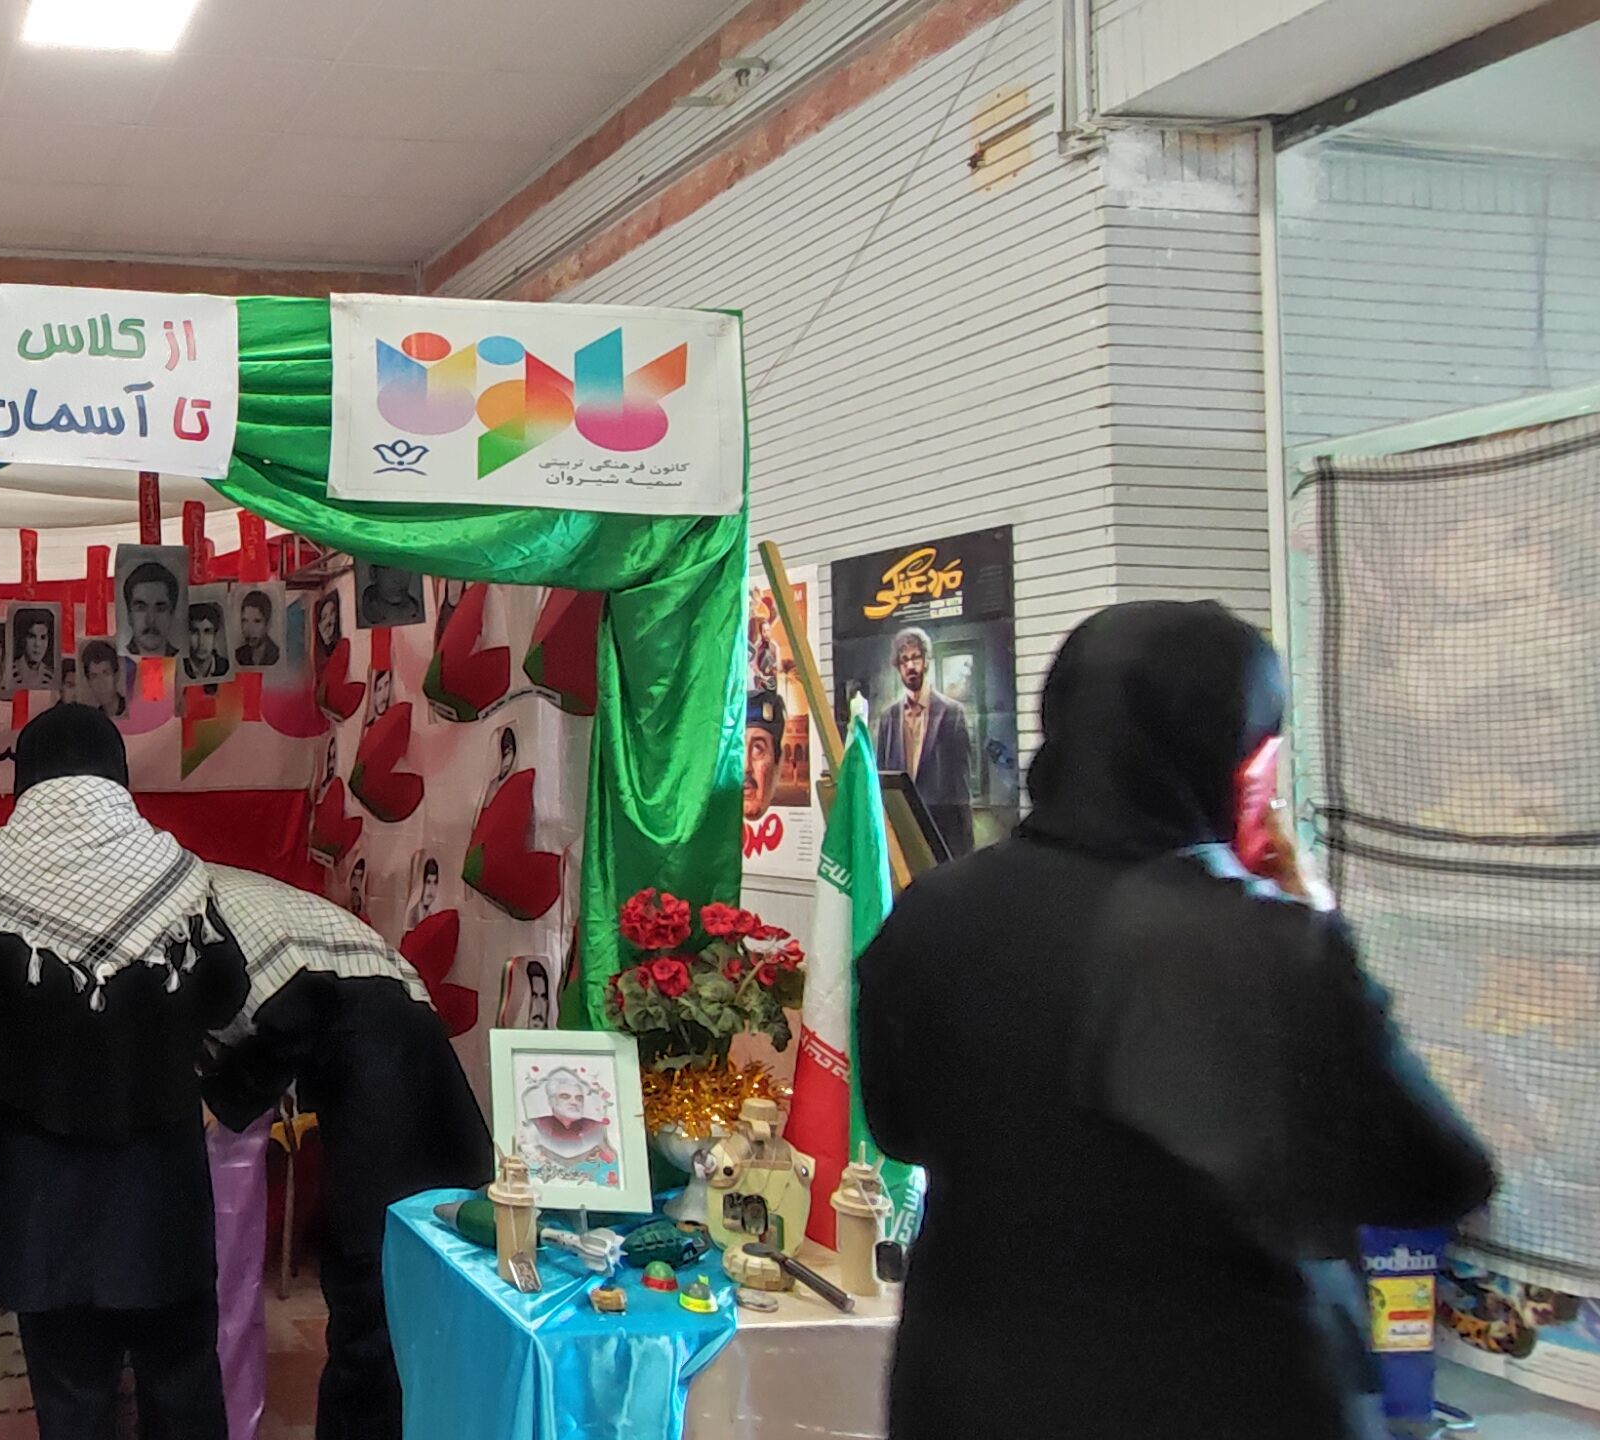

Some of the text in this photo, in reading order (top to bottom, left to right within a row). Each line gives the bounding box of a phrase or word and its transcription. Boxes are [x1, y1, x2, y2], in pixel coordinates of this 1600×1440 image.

[17, 313, 197, 371] از کلاس
[173, 397, 212, 442] تا
[538, 458, 585, 470] تربیتی
[649, 462, 691, 475] کانون
[545, 471, 683, 490] سمیه شیروان
